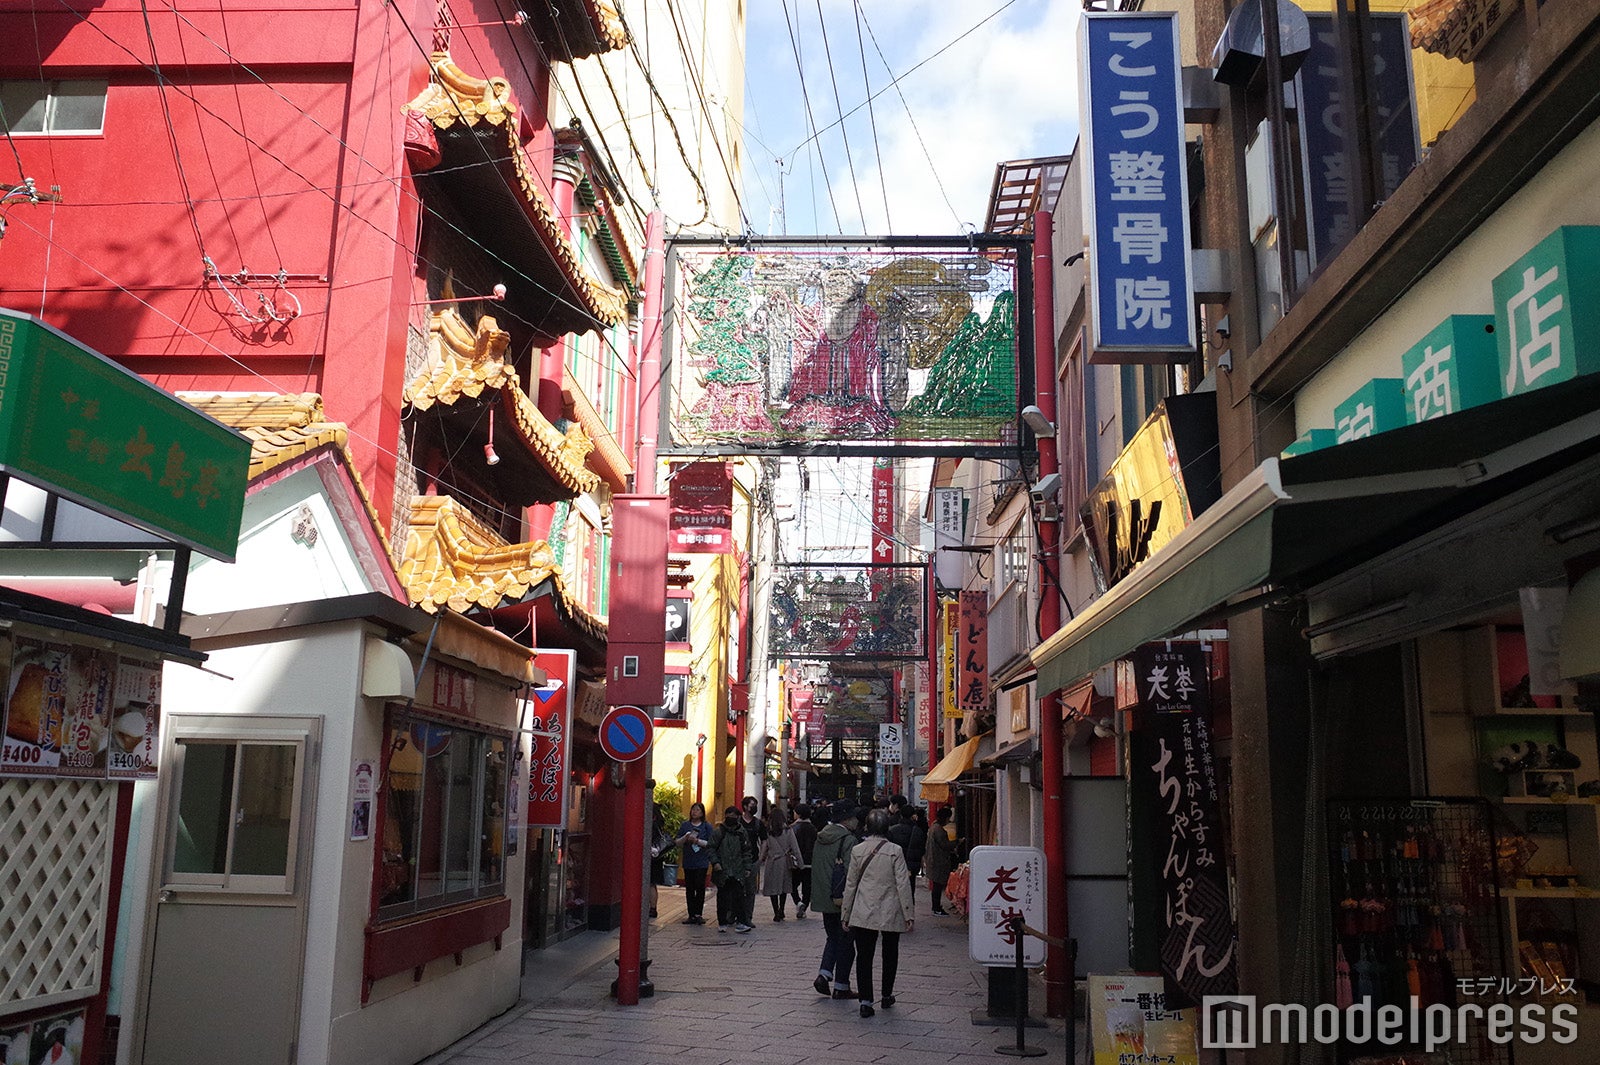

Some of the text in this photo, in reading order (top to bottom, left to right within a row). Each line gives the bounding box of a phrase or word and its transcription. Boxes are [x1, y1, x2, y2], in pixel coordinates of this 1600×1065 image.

[1107, 30, 1173, 332] こう整骨院
[43, 653, 62, 752] えびハトシ
[963, 623, 985, 705] どん底
[2, 744, 41, 763] ¥400
[67, 752, 95, 767] ¥400
[113, 753, 142, 768] ¥400
[540, 713, 563, 802] ちゃんぽん
[1181, 718, 1216, 868] 元祖生からすみ
[1151, 737, 1234, 982] ちゃんぽん
[1121, 992, 1169, 1011] 一番搾
[1144, 1010, 1184, 1022] 生ビール
